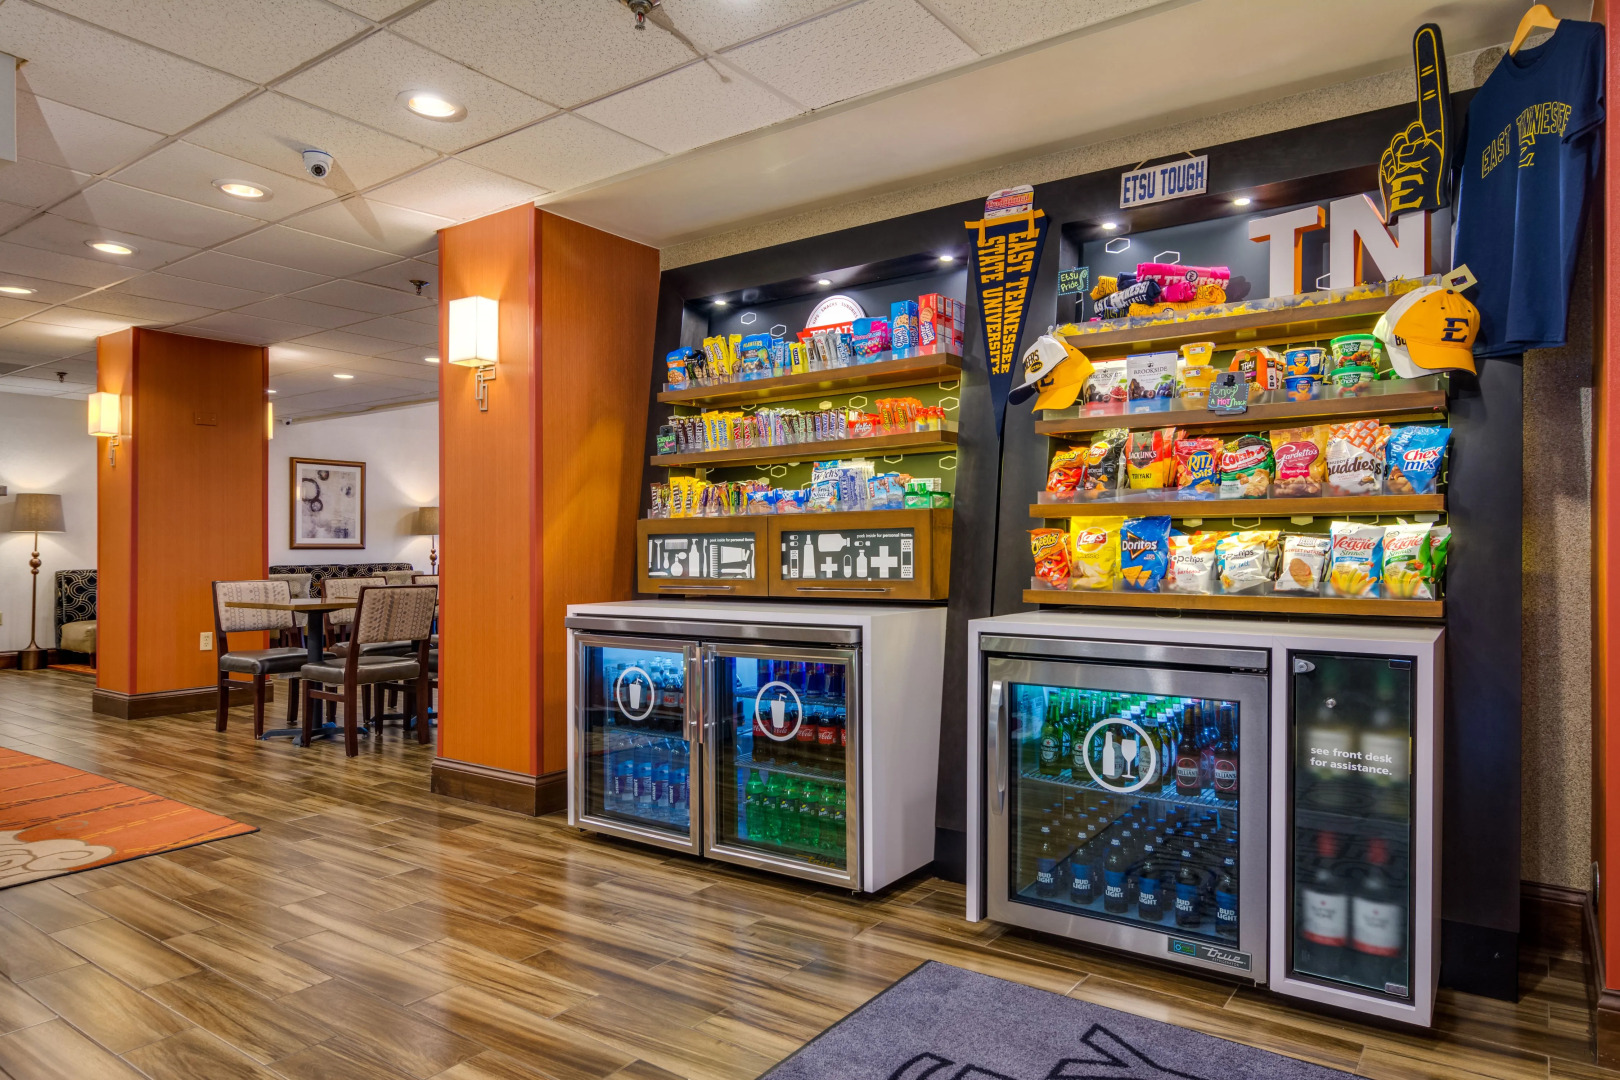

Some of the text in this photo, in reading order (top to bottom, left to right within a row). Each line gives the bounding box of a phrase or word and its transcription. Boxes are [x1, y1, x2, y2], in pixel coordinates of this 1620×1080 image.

[1482, 123, 1512, 179] EAST
[1123, 160, 1205, 204] ETSU TOUGH
[1006, 228, 1041, 273] EAST
[977, 235, 1006, 284] STATE
[982, 287, 1004, 375] UNIVERSITY
[1000, 276, 1030, 374] TENNESSEE
[1441, 317, 1470, 343] E
[1133, 366, 1168, 375] BROOKSIDE
[1276, 444, 1317, 470] Gardetto's
[1403, 447, 1442, 461] Chex
[1188, 454, 1213, 472] RITZ
[1403, 458, 1436, 472] mix
[1193, 468, 1212, 479] bits
[1032, 533, 1059, 554] Cheetos
[1080, 531, 1104, 544] Lay's
[1333, 535, 1375, 550] Veggie
[1383, 535, 1423, 551] Veggie
[1122, 540, 1158, 551] Doritos
[1310, 747, 1393, 763] see front desk
[1310, 757, 1393, 776] for assistance.
[1036, 875, 1054, 884] LIGHT
[1072, 882, 1091, 890] LIGHT
[1105, 889, 1124, 898] LIGHT
[1139, 896, 1157, 906] LIGHT
[1140, 892, 1154, 900] BUD
[1217, 911, 1238, 921] LIGHT
[1219, 907, 1235, 915] BUD
[1202, 946, 1245, 965] True
